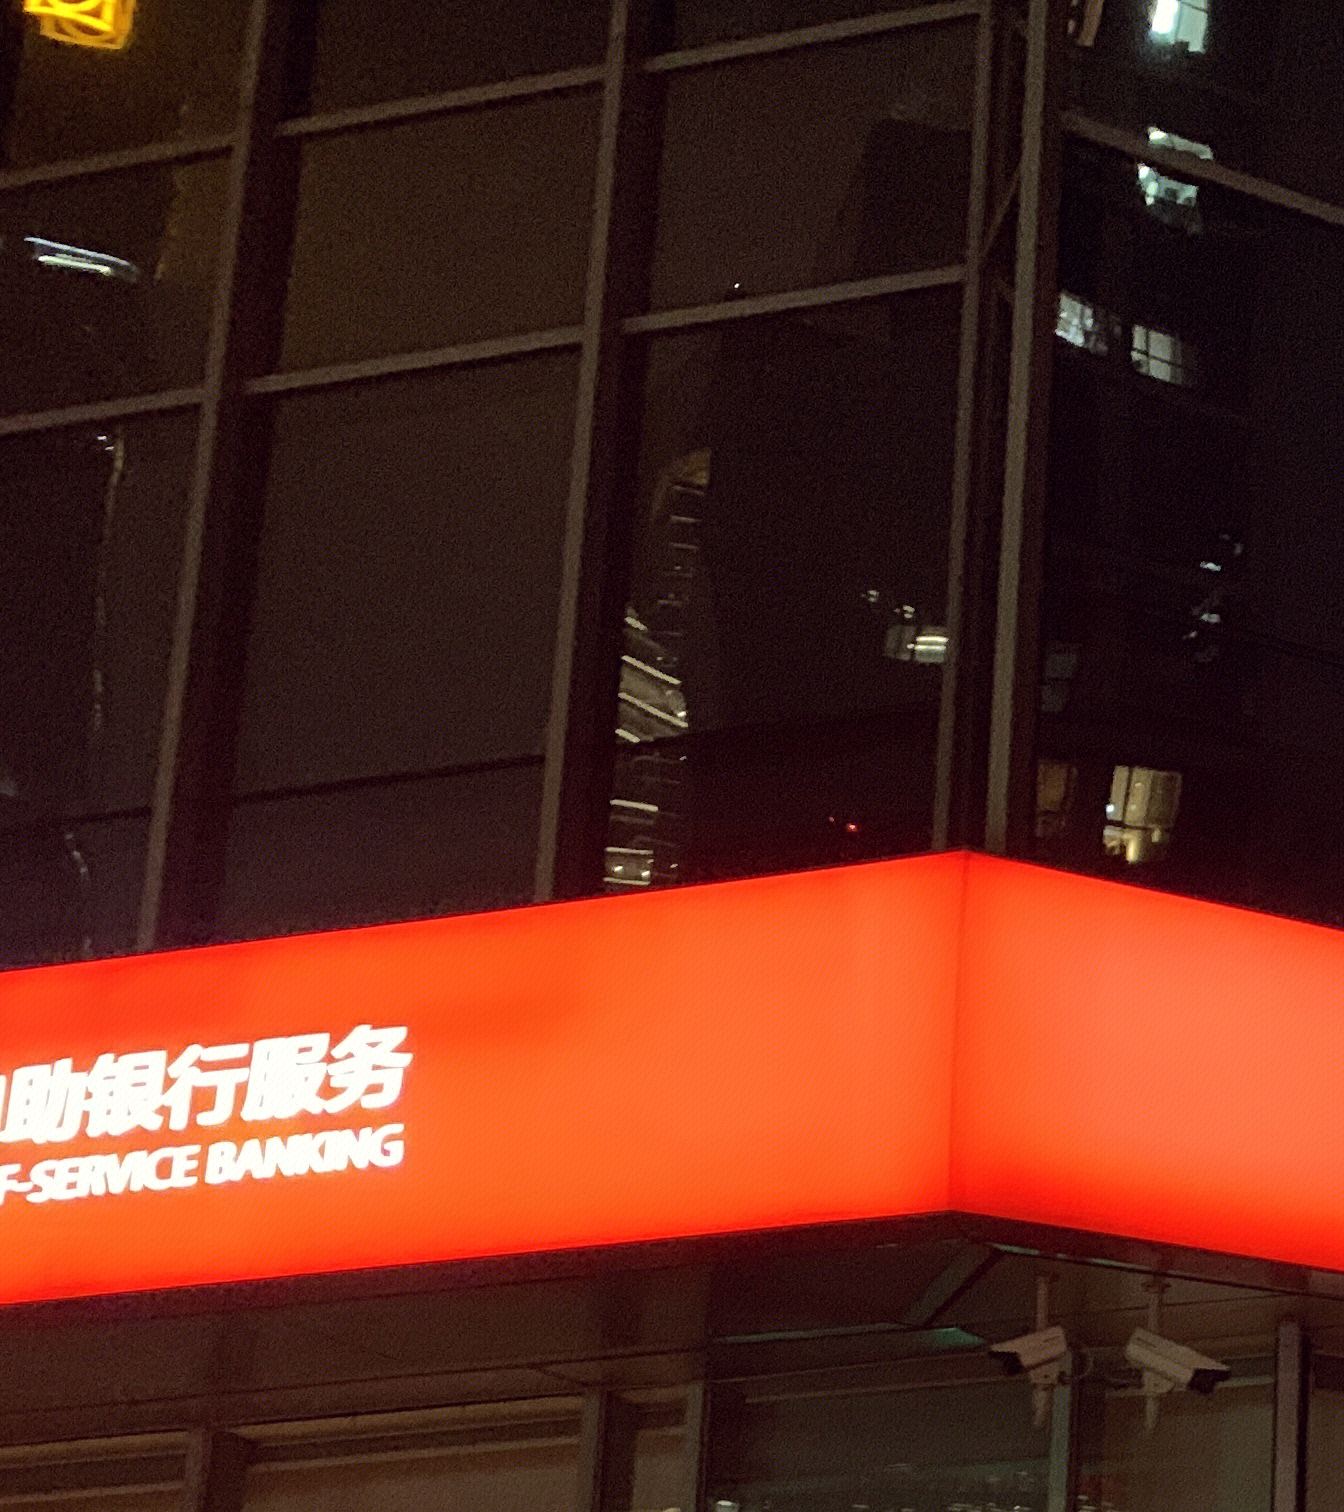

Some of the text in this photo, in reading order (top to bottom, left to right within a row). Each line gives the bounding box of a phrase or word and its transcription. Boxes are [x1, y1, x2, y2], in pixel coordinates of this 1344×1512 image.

[0, 1025, 413, 1144] 助银行服务
[205, 1124, 404, 1184] BANKING
